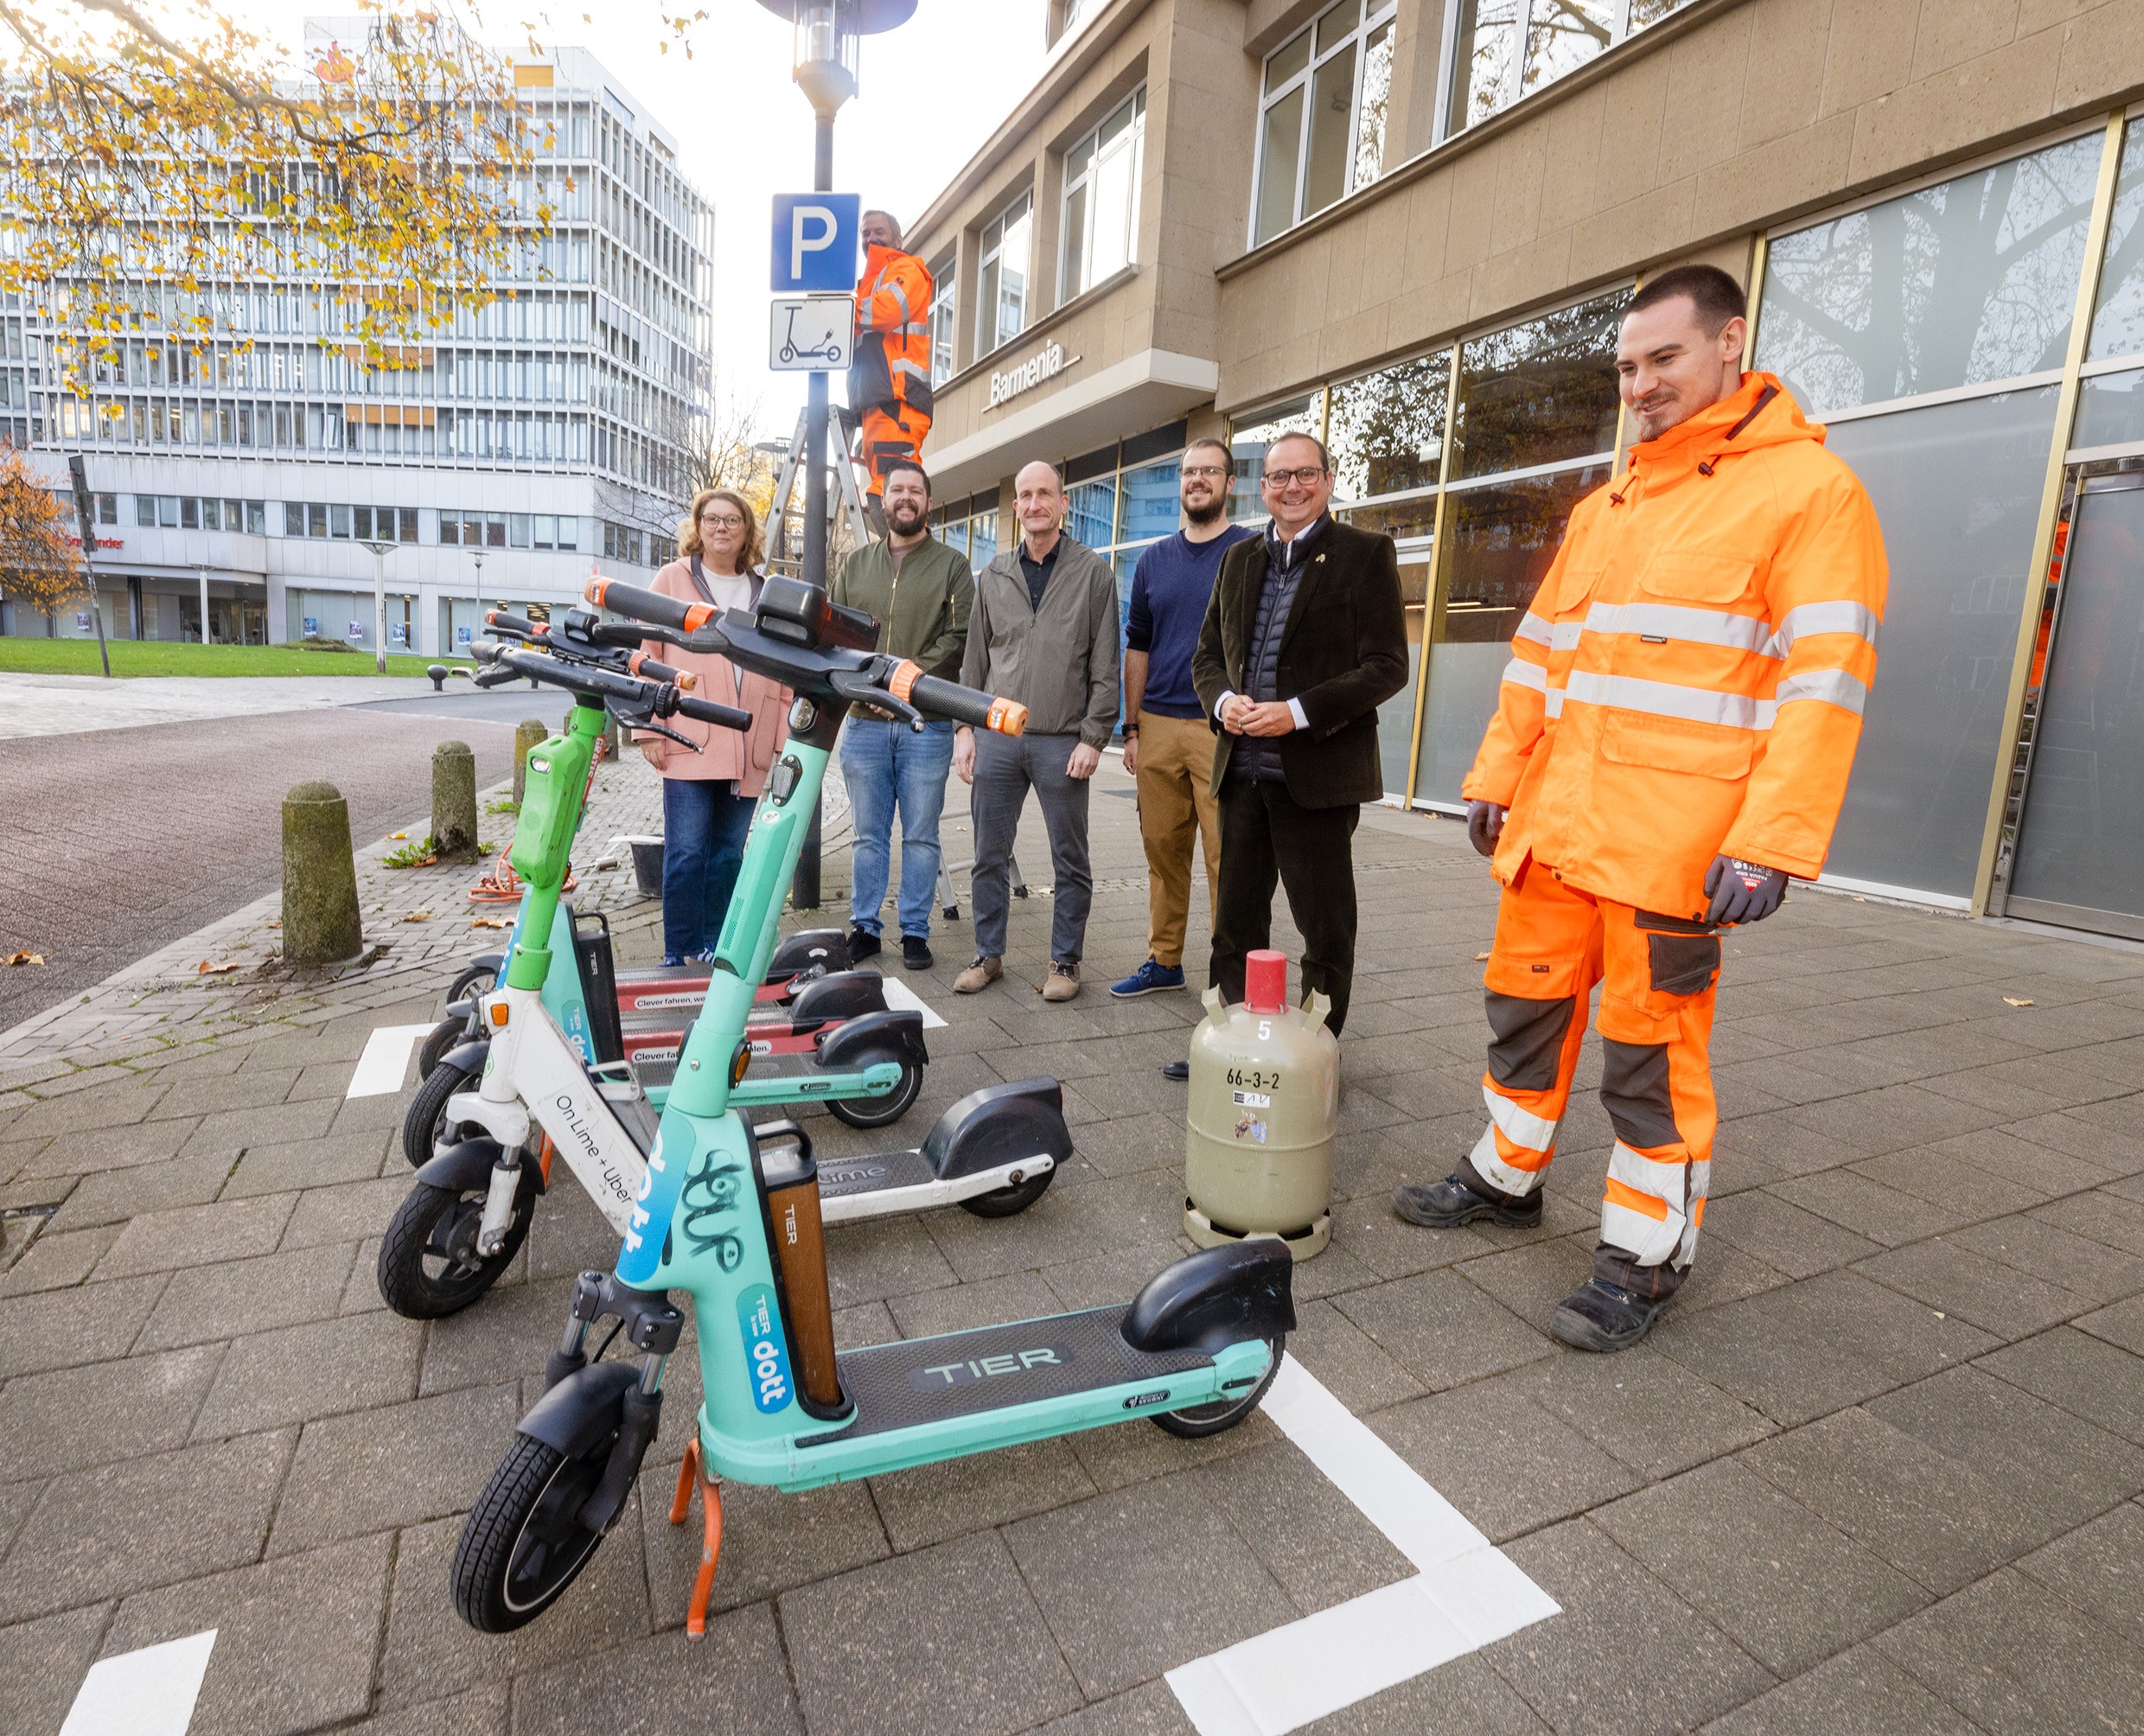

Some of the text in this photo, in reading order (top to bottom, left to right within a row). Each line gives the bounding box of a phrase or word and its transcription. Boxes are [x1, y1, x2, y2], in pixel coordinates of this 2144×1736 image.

[791, 206, 838, 280] P
[989, 338, 1064, 407] Barmenia
[590, 951, 598, 976] TIER
[573, 1006, 582, 1031] TIER
[636, 999, 663, 1007] Clever
[665, 997, 692, 1005] fahren,
[1257, 1020, 1272, 1041] 5
[635, 1052, 665, 1062] Clever
[1227, 1068, 1279, 1089] 66-3-2
[557, 1095, 575, 1120] On
[571, 1119, 599, 1158] Lime
[603, 1167, 633, 1203] Uber
[784, 1203, 798, 1246] TIER
[756, 1293, 771, 1336] TIER
[753, 1340, 787, 1406] dott
[924, 1348, 1062, 1384] TIER
